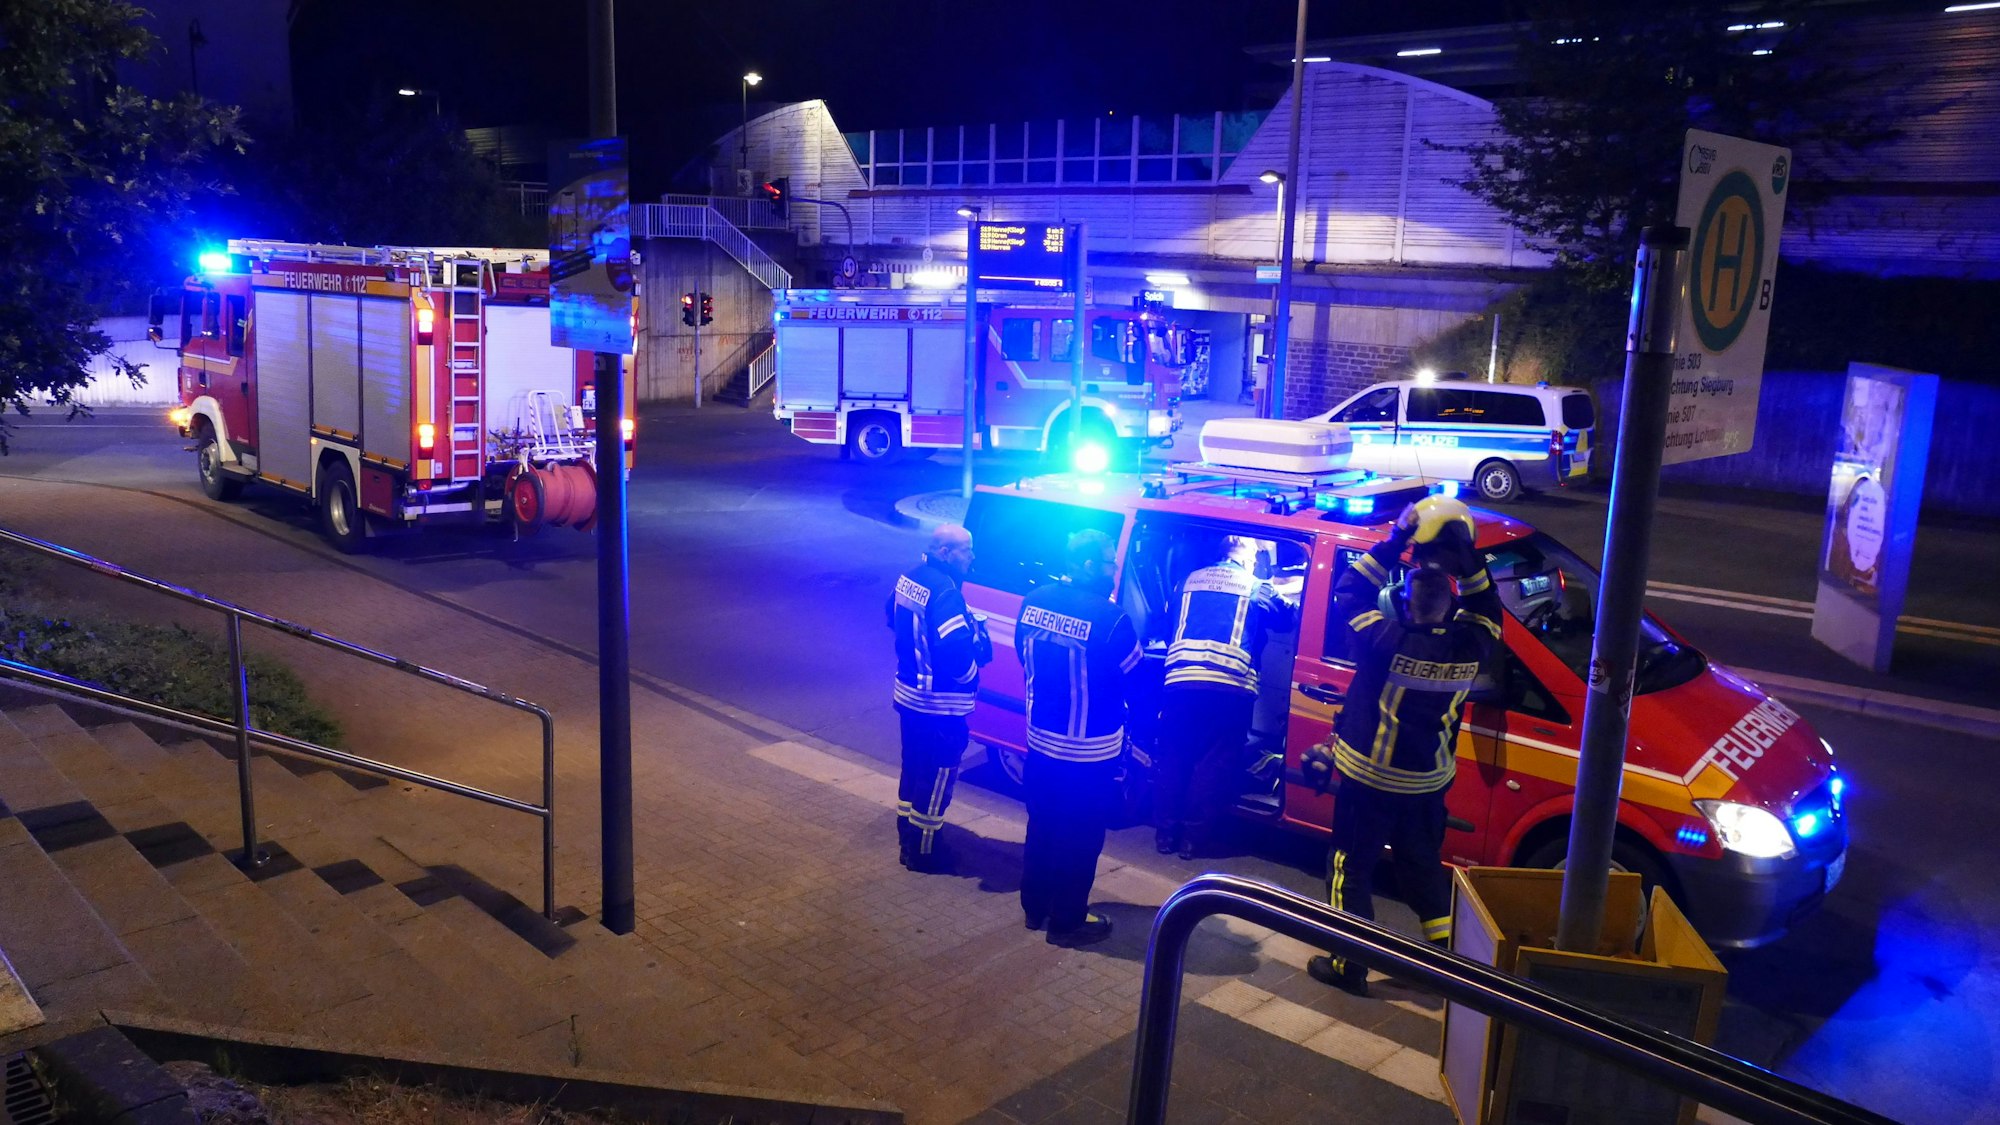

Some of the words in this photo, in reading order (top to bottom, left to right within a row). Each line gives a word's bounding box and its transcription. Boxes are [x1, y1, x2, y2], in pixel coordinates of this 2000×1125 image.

[1772, 163, 1785, 176] VRS
[1708, 211, 1748, 312] H
[284, 271, 342, 292] FEUERWEHR
[352, 275, 366, 293] 112
[1759, 279, 1770, 311] B
[808, 308, 898, 320] FEUERWEHR
[922, 308, 942, 320] 112
[1687, 353, 1702, 370] 503
[1670, 379, 1698, 397] chtung
[1700, 377, 1734, 396] Siegburg
[1682, 406, 1696, 423] 507
[1411, 434, 1458, 447] POLIZEI
[1665, 432, 1694, 449] chtung
[1023, 607, 1088, 639] FEUERWEHR
[1393, 656, 1476, 680] FEUERWEHR
